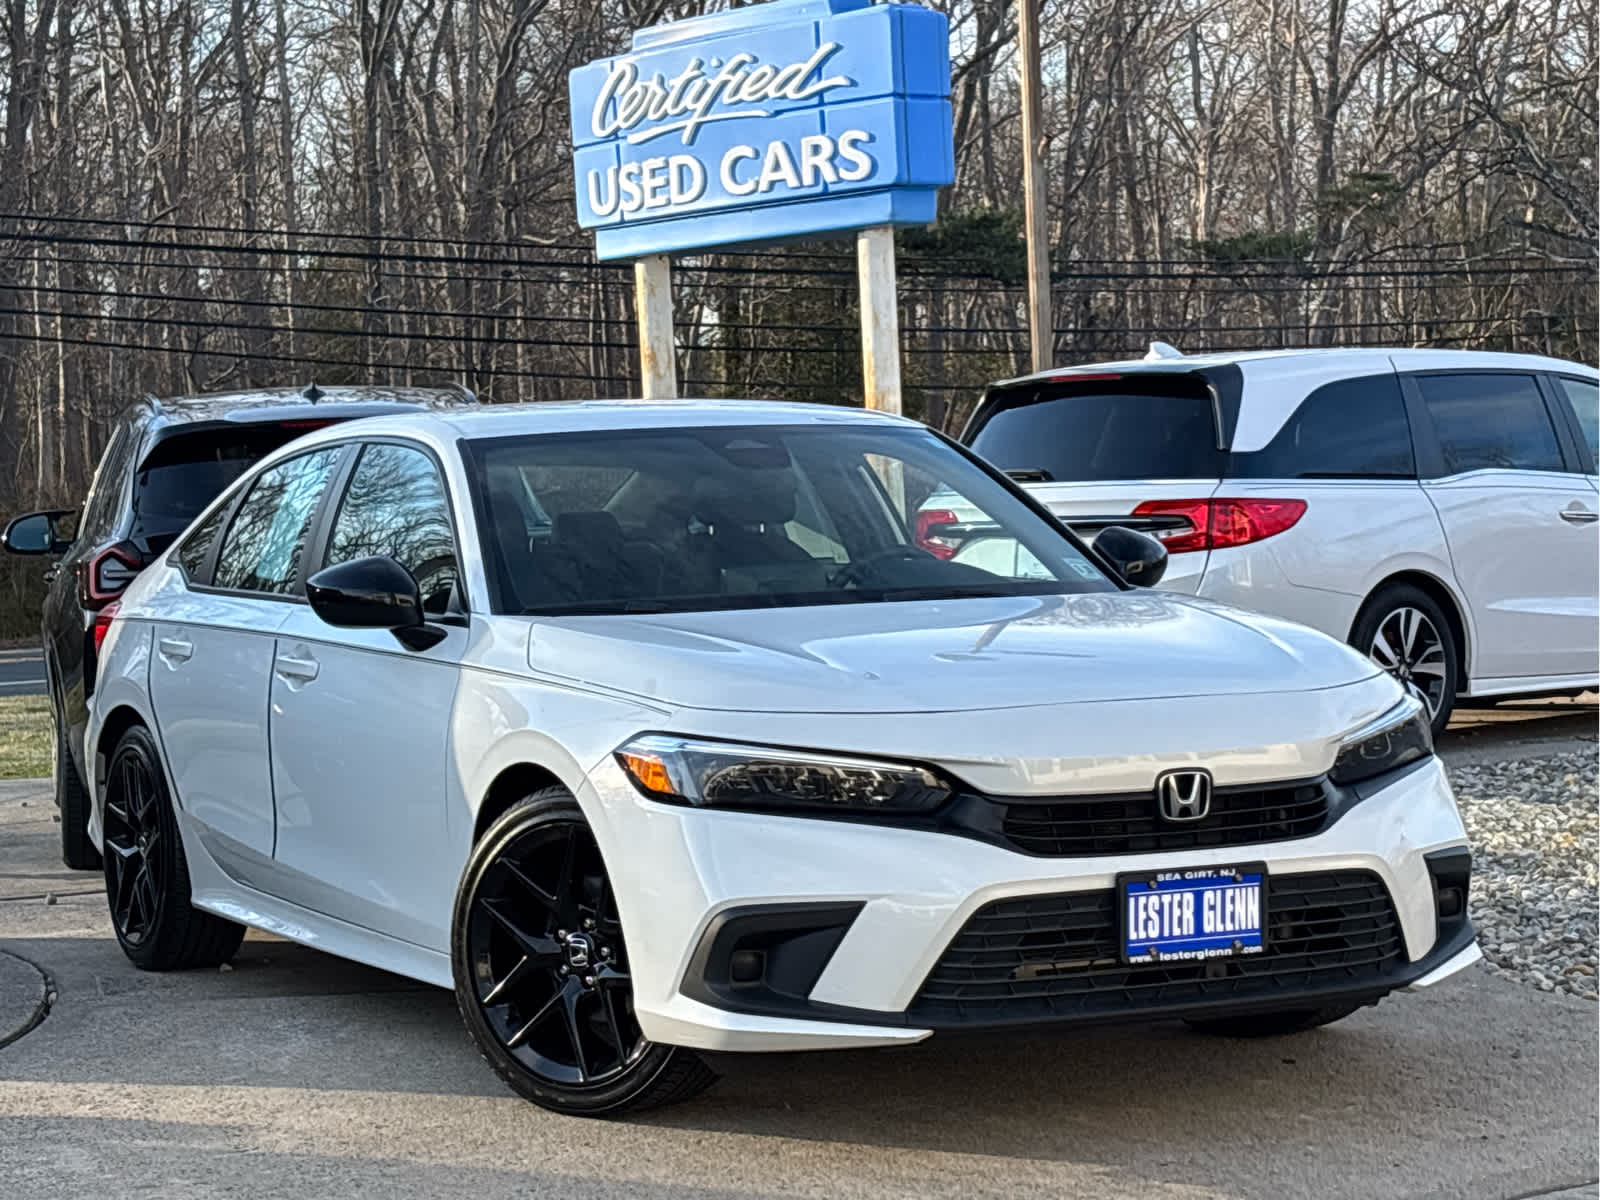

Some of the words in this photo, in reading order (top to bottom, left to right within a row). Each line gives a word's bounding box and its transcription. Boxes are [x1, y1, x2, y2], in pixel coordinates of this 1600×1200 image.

[592, 42, 858, 145] Certified
[587, 154, 705, 217] USED
[719, 129, 876, 196] CARS
[1157, 872, 1181, 882] SEA
[1184, 870, 1217, 880] GIRT,
[1220, 868, 1236, 877] NJ
[1128, 892, 1195, 940] LESTER
[1202, 886, 1260, 934] GLENN
